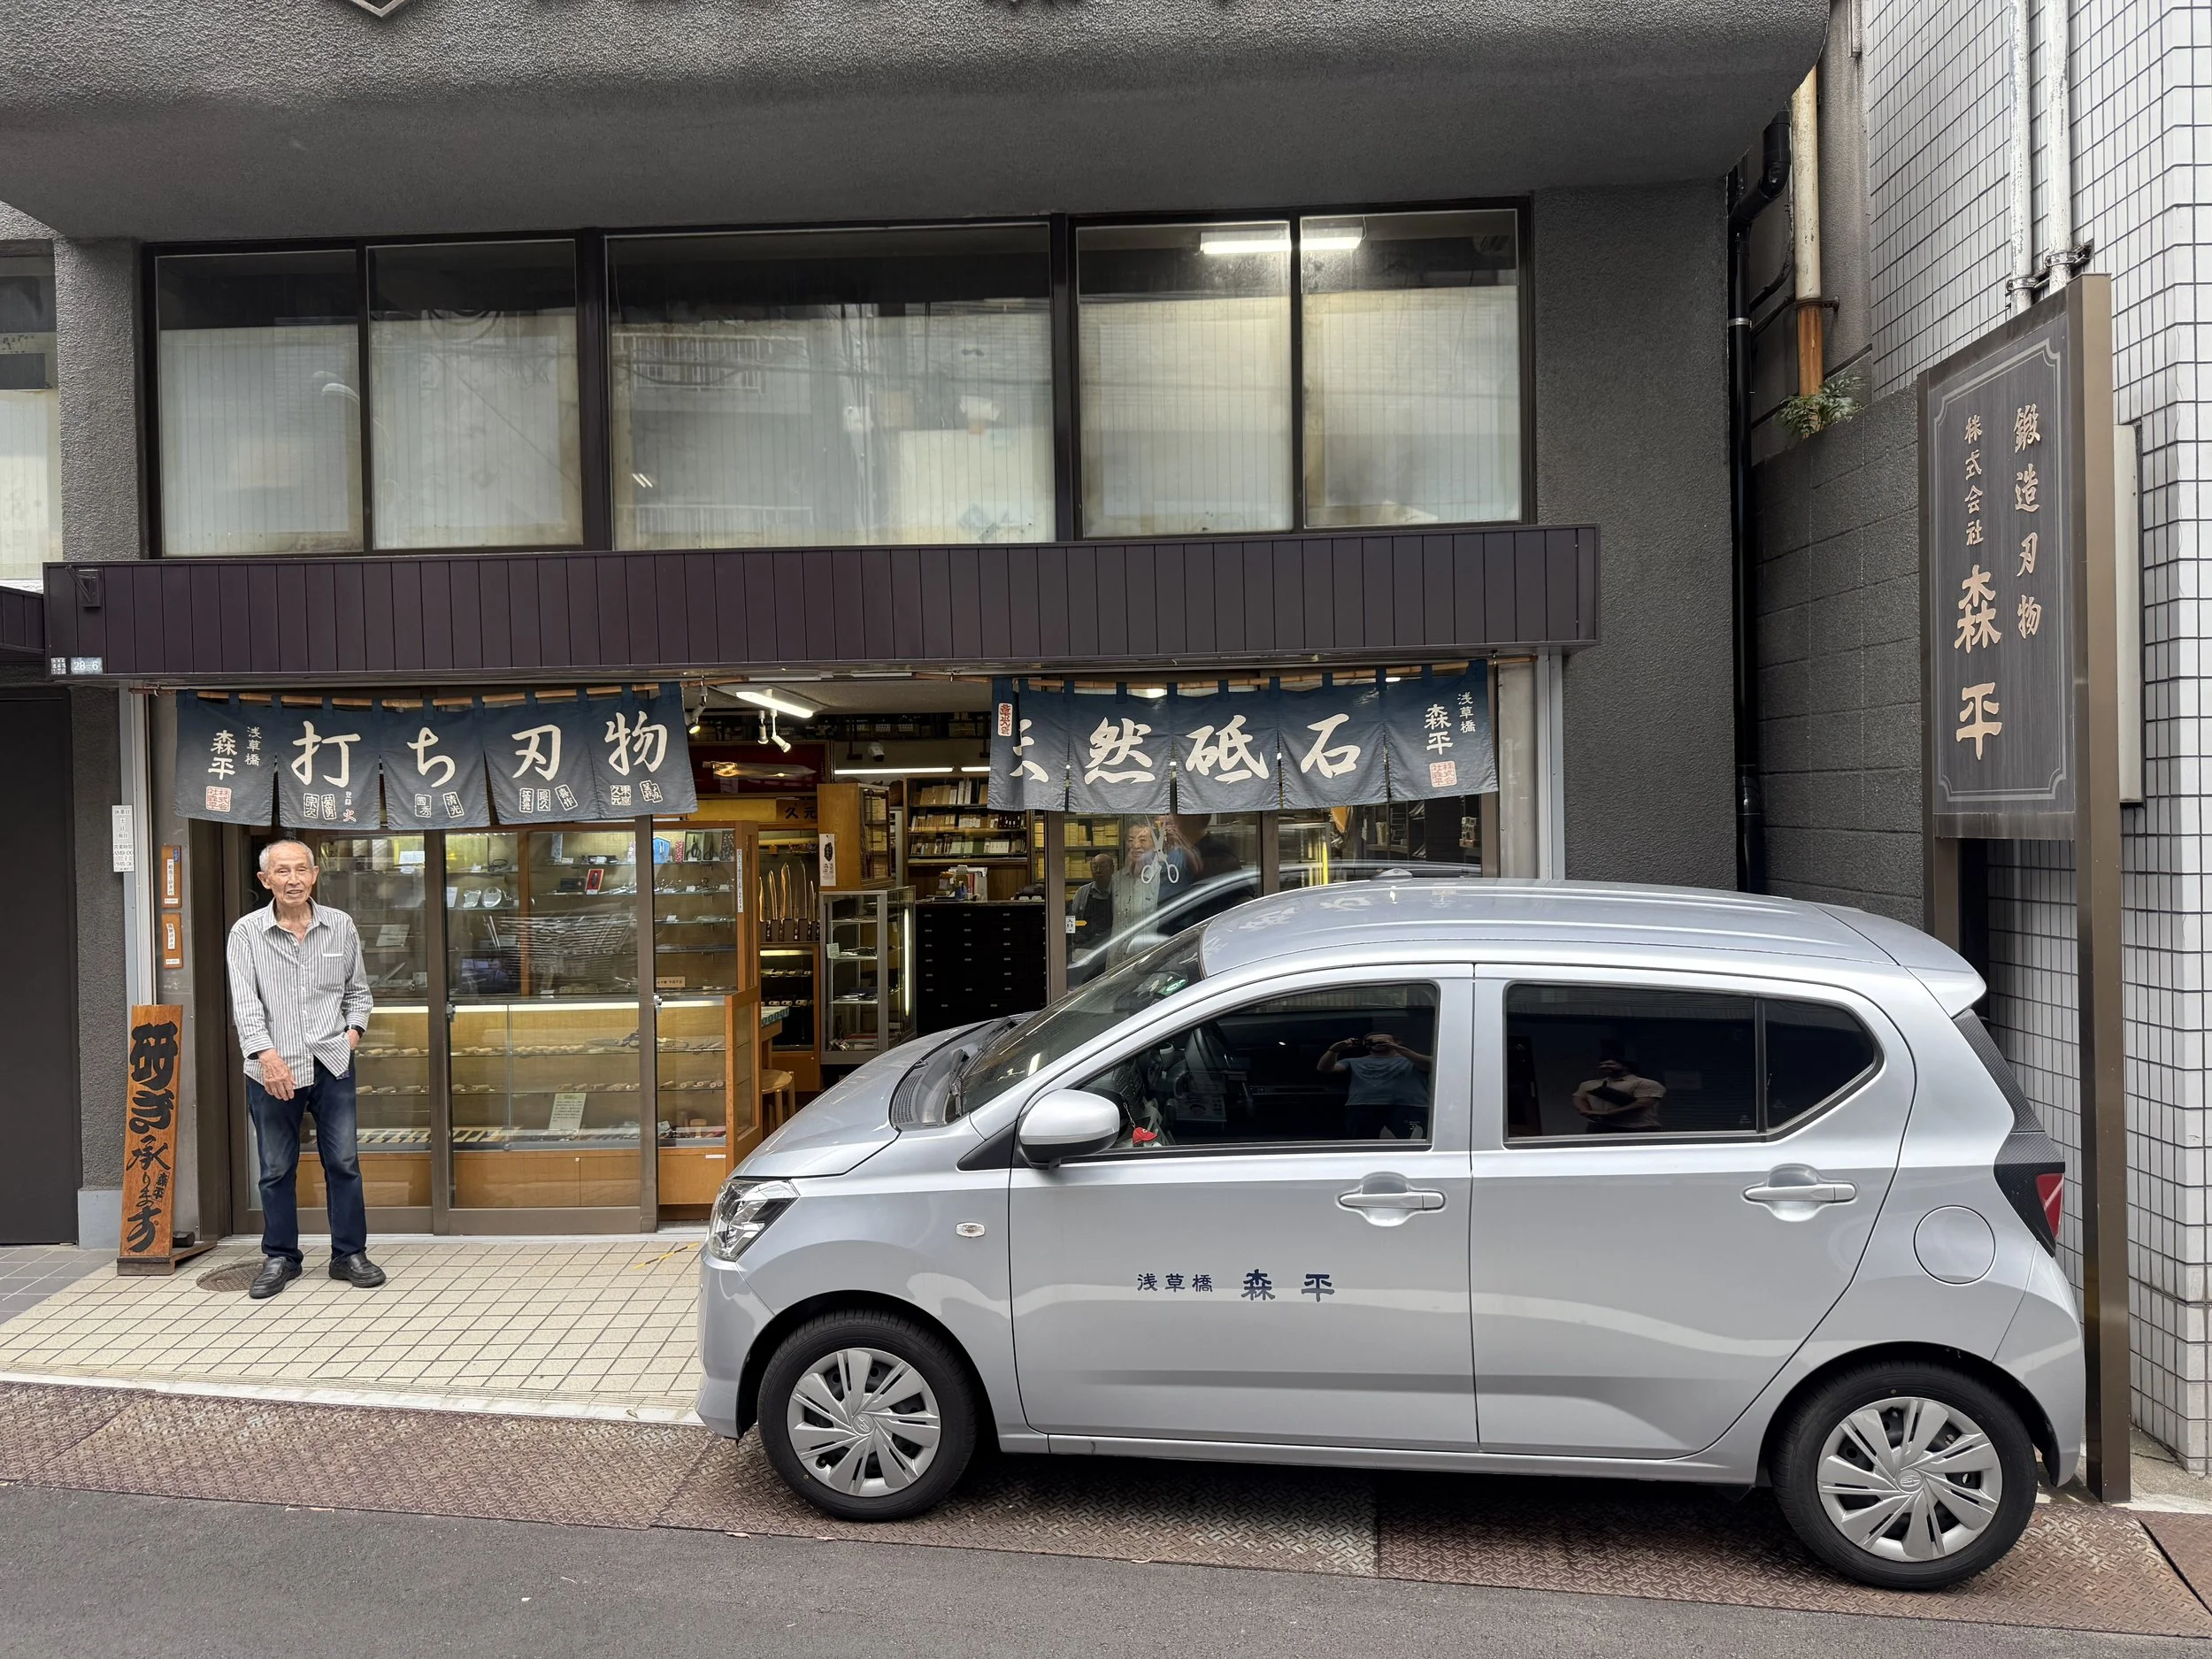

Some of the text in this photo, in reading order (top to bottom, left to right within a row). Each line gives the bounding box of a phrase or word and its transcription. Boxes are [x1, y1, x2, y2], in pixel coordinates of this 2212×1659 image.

[2014, 403, 2041, 639] 鍛造刃物
[1954, 414, 2002, 760] 株式会社 森平
[73, 661, 98, 671] 28-6
[1425, 703, 1454, 756] 森平
[1457, 691, 1476, 733] 浅草橋
[208, 730, 237, 780] 森平
[244, 726, 262, 766] 浅草橋
[291, 710, 667, 788] 打ち刃物
[1137, 1269, 1335, 1302] 浅草橋 森平
